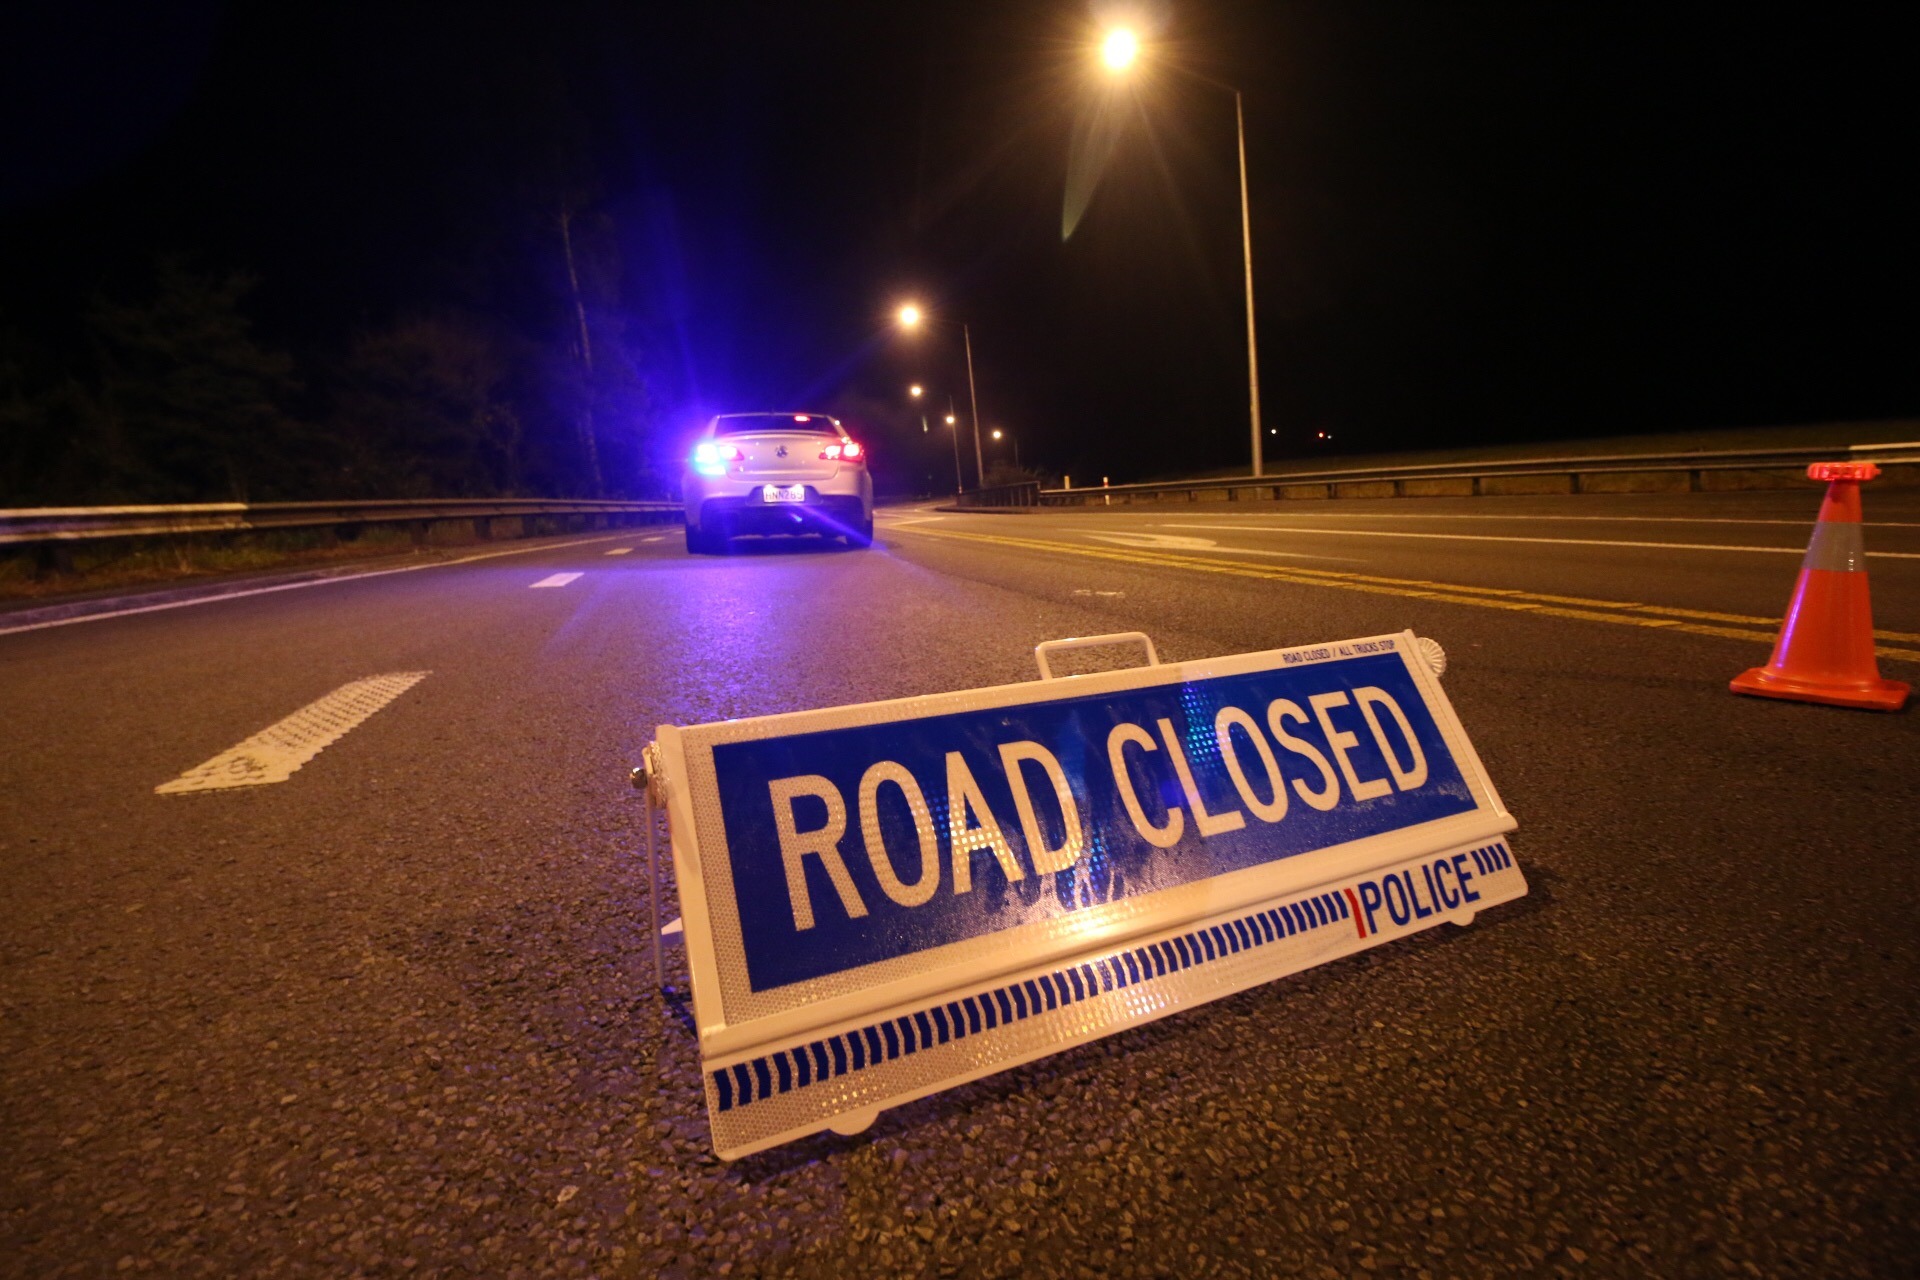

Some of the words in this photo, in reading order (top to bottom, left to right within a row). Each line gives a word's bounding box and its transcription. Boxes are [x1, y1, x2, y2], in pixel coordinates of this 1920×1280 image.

[1282, 652, 1303, 664] ROAD
[1303, 648, 1331, 661] CLOSED
[1339, 646, 1354, 656] ALL
[1352, 642, 1379, 654] TRUCKS
[1378, 639, 1395, 651] STOP
[768, 740, 1083, 932] ROAD
[1107, 685, 1429, 849] CLOSED
[1358, 853, 1481, 934] POLICE
